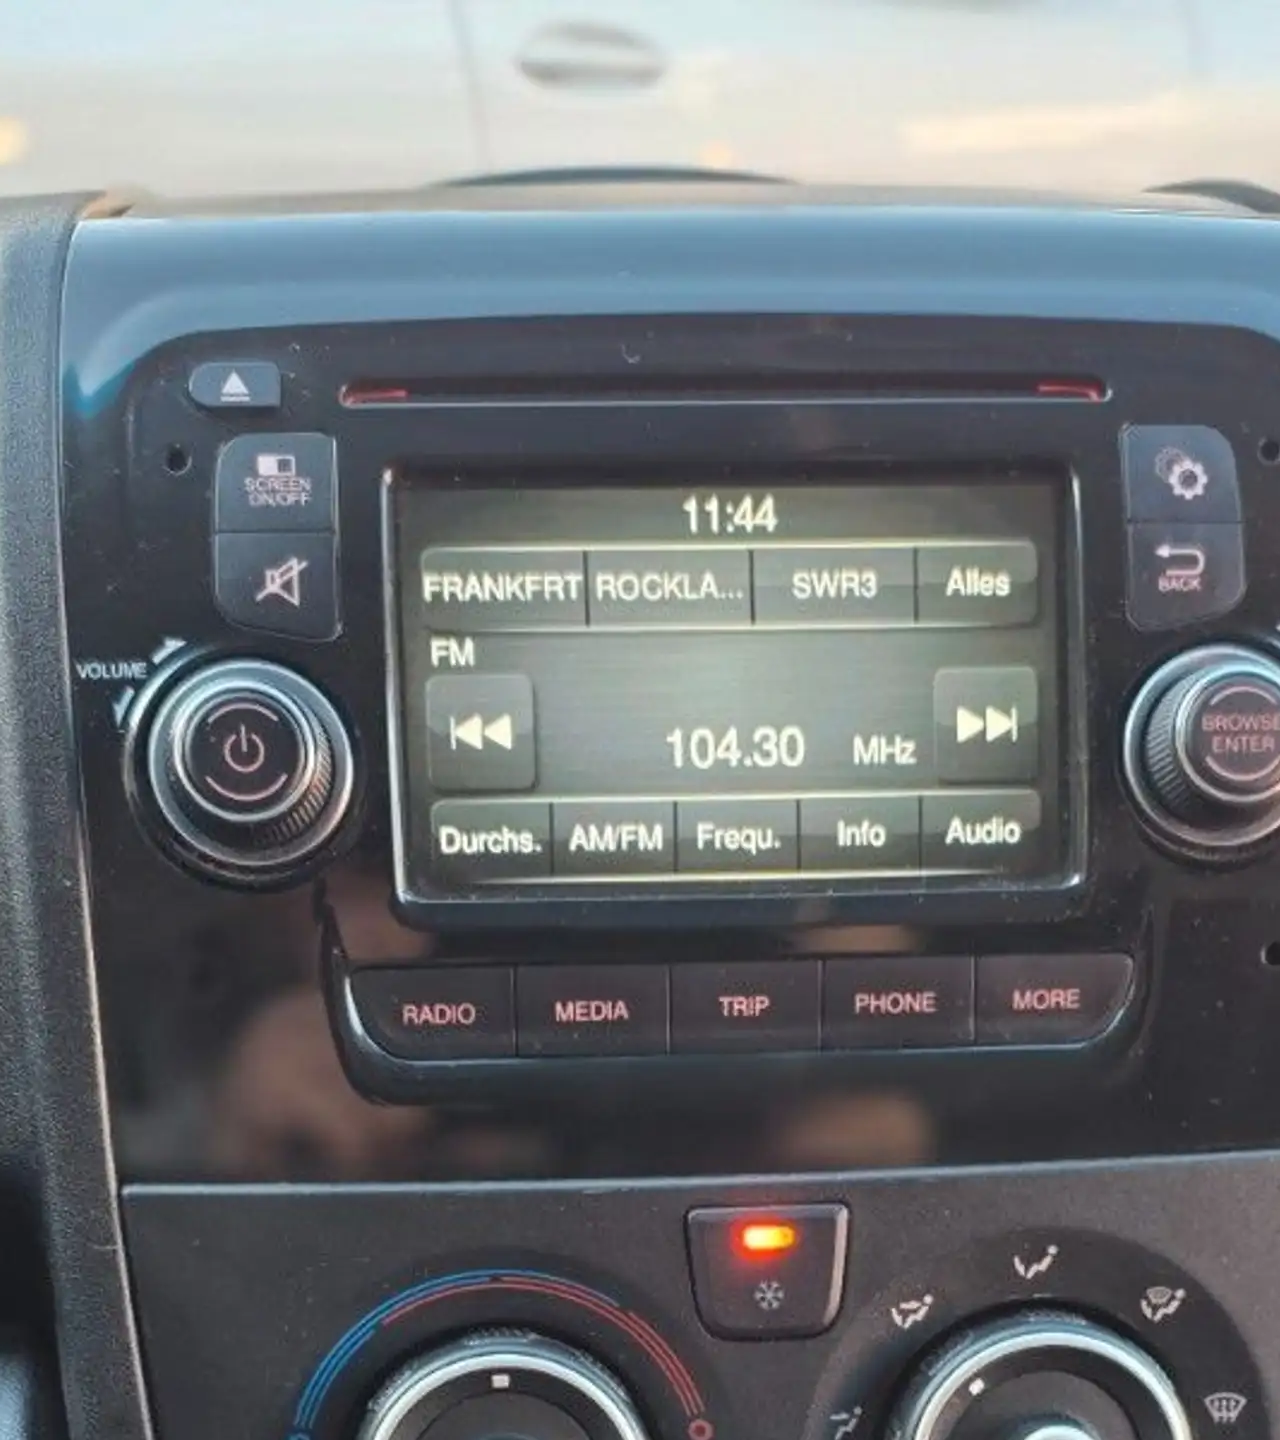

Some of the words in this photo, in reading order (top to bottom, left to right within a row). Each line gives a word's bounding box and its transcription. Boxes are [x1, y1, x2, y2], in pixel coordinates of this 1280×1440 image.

[243, 476, 312, 492] SCREEN
[682, 495, 778, 535] 11:44
[423, 572, 582, 602] FRANKFRT
[596, 574, 744, 602] ROCKLA...
[791, 570, 877, 599] SWR3
[945, 567, 1010, 597] Alles
[1157, 576, 1203, 593] BACK
[430, 638, 475, 668] FM
[75, 662, 148, 681] VOLUME
[665, 727, 806, 769] 104.30
[852, 735, 917, 765] MHz
[1211, 734, 1275, 752] ENTER
[439, 824, 543, 855] Durchs.
[568, 823, 664, 853] AM/FM
[696, 821, 781, 855] Frequ.
[837, 820, 887, 848] Info
[945, 817, 1022, 846] Audio
[554, 999, 629, 1024] MEDIA
[718, 995, 771, 1018] TRIP
[853, 991, 938, 1015] PHONE
[1011, 987, 1081, 1012] MORE
[402, 1003, 477, 1027] RADIO
